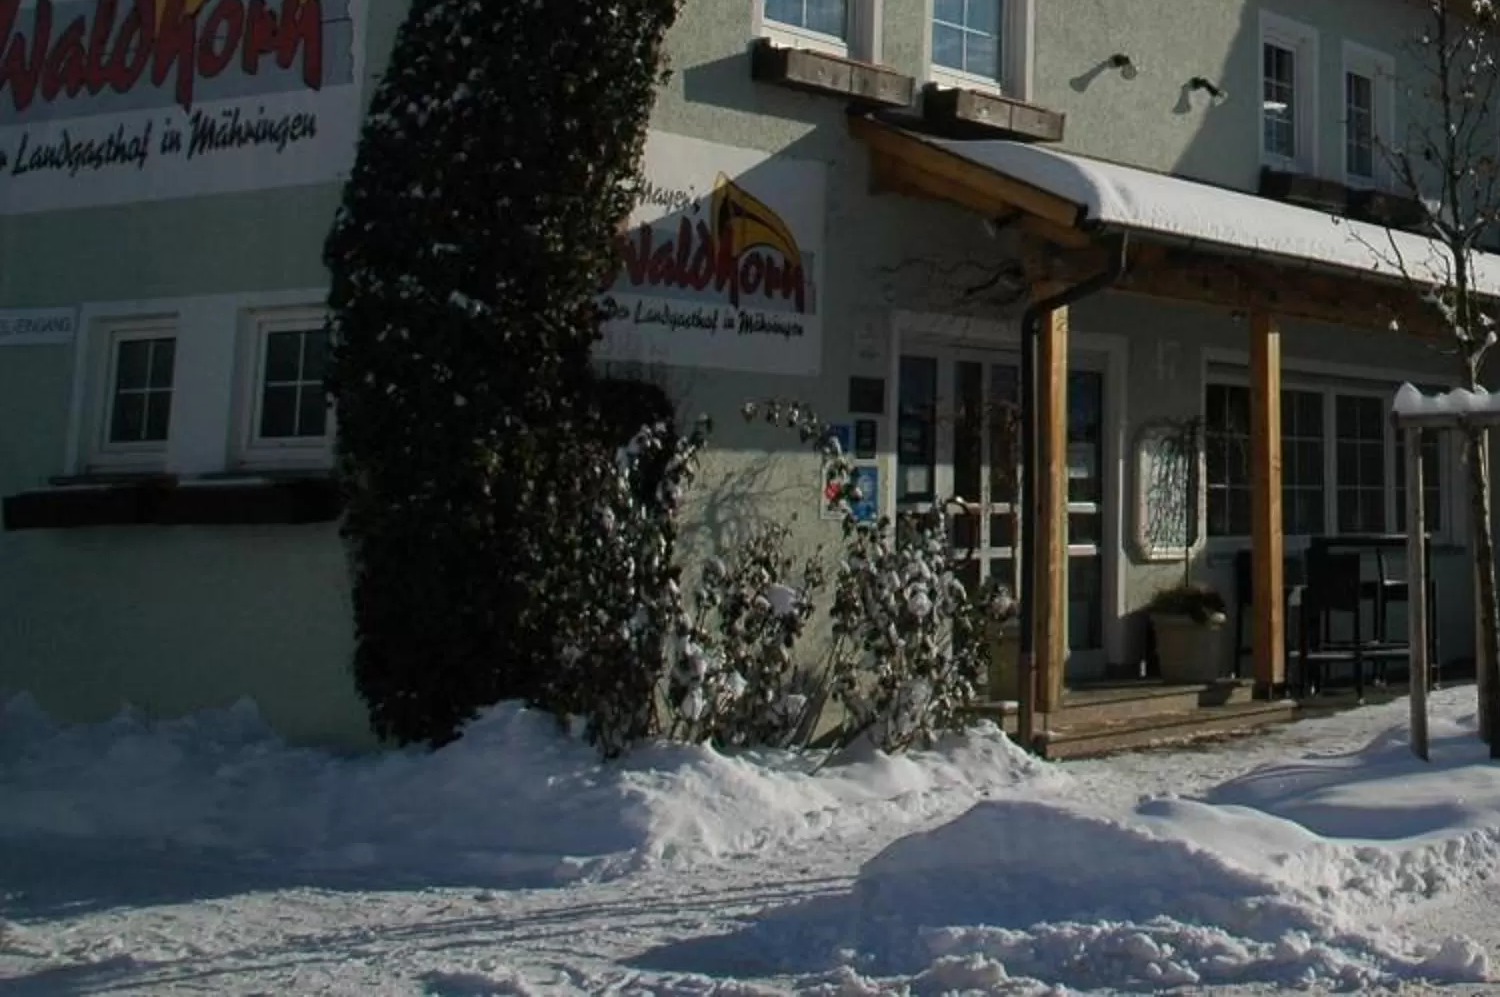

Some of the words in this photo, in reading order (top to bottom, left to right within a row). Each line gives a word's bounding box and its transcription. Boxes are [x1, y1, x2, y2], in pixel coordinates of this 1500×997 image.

[11, 119, 152, 178] Landgasthof
[160, 118, 181, 155] in
[187, 106, 317, 161] Mähringen
